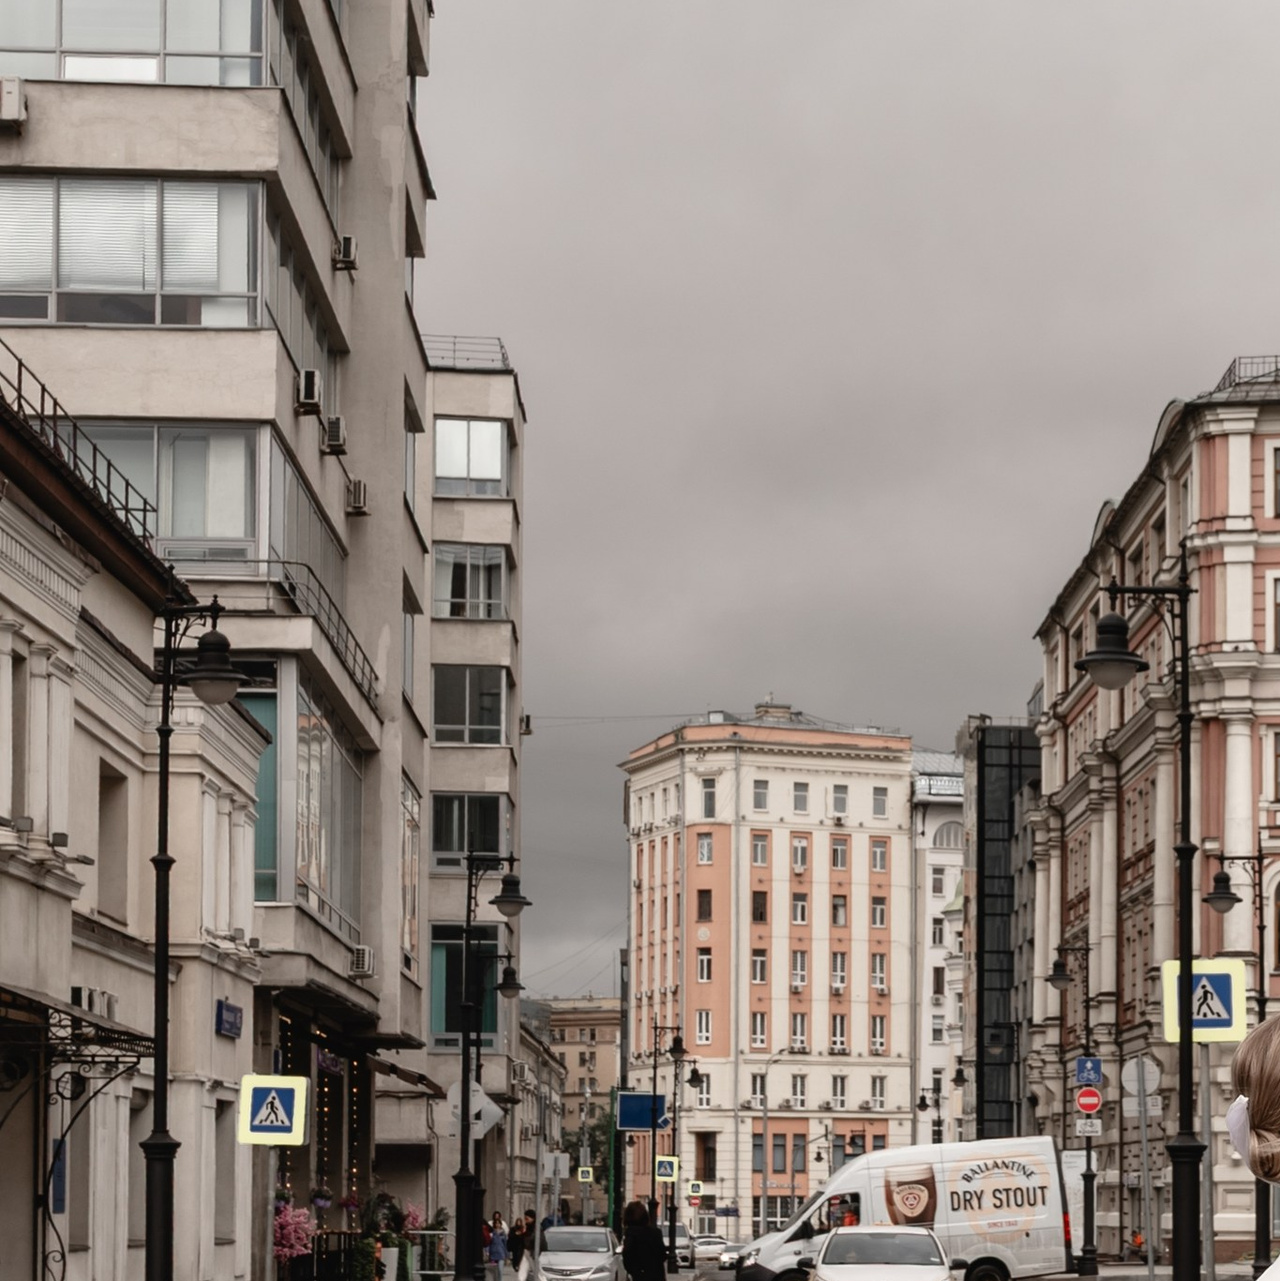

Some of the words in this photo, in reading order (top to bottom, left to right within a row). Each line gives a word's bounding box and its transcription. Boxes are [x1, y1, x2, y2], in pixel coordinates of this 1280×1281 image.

[961, 1159, 1036, 1184] BALLANTINE
[950, 1189, 984, 1212] DRY
[992, 1185, 1048, 1209] STOUT
